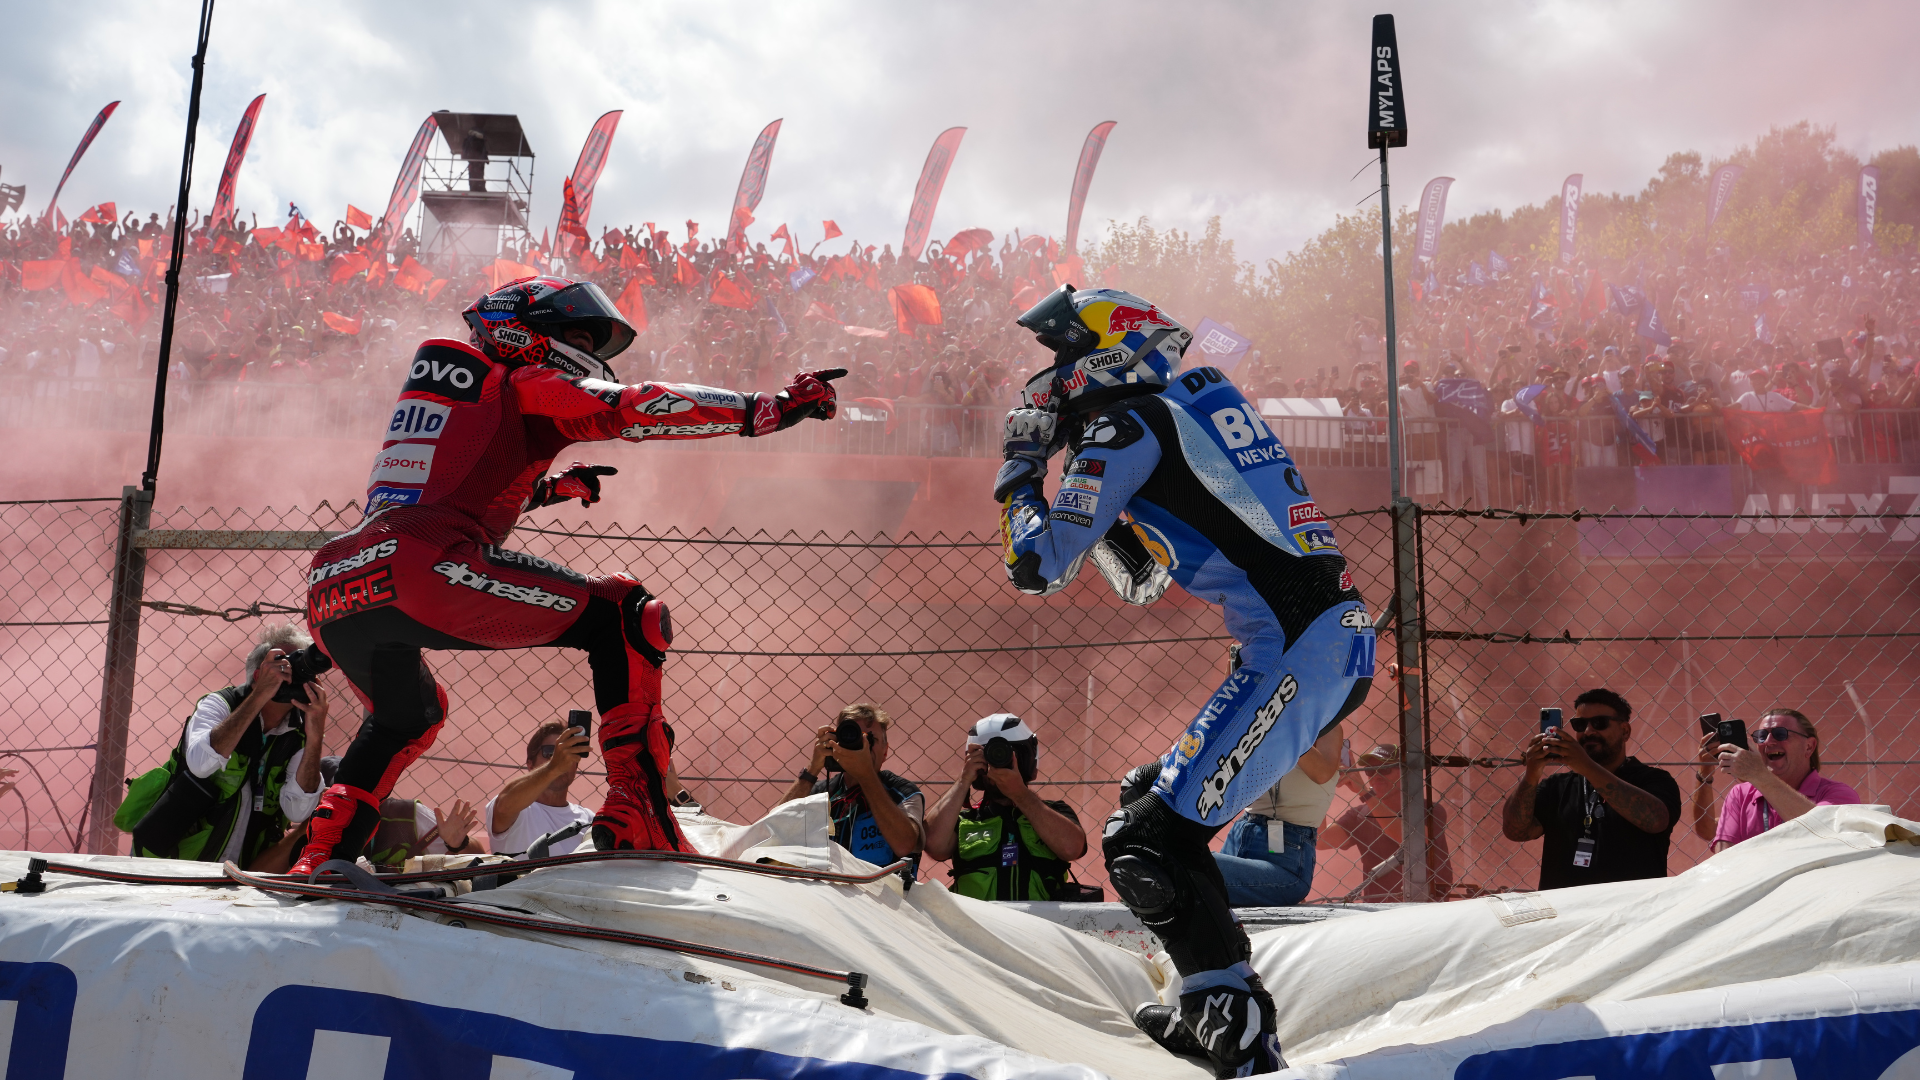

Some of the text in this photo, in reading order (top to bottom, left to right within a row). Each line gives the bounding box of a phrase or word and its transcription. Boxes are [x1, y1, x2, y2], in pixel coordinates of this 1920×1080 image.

[1376, 46, 1395, 128] MYLAPS
[1565, 183, 1579, 243] ALEX73
[1862, 173, 1877, 234] ALEX73
[484, 300, 515, 311] Galicia
[528, 308, 553, 316] VERTICAL
[497, 329, 528, 345] SHOEI
[1069, 319, 1089, 334] VERTICAL
[1209, 331, 1236, 349] BLUE
[548, 351, 585, 377] Lenovo
[1089, 352, 1124, 370] SHOEI
[405, 359, 474, 389] ovo
[697, 391, 737, 404] Unipol
[387, 405, 444, 435] ello
[620, 421, 744, 439] alpinestars
[382, 457, 427, 470] Sport
[1236, 443, 1286, 467] NEWS
[1070, 482, 1099, 493] GLOBAL
[1058, 492, 1078, 508] DEA
[489, 543, 577, 577] Lenovo
[309, 569, 393, 625] MARC
[432, 561, 577, 612] alpinestars
[1197, 671, 1250, 730] NEWS
[1196, 673, 1299, 821] alpinestars
